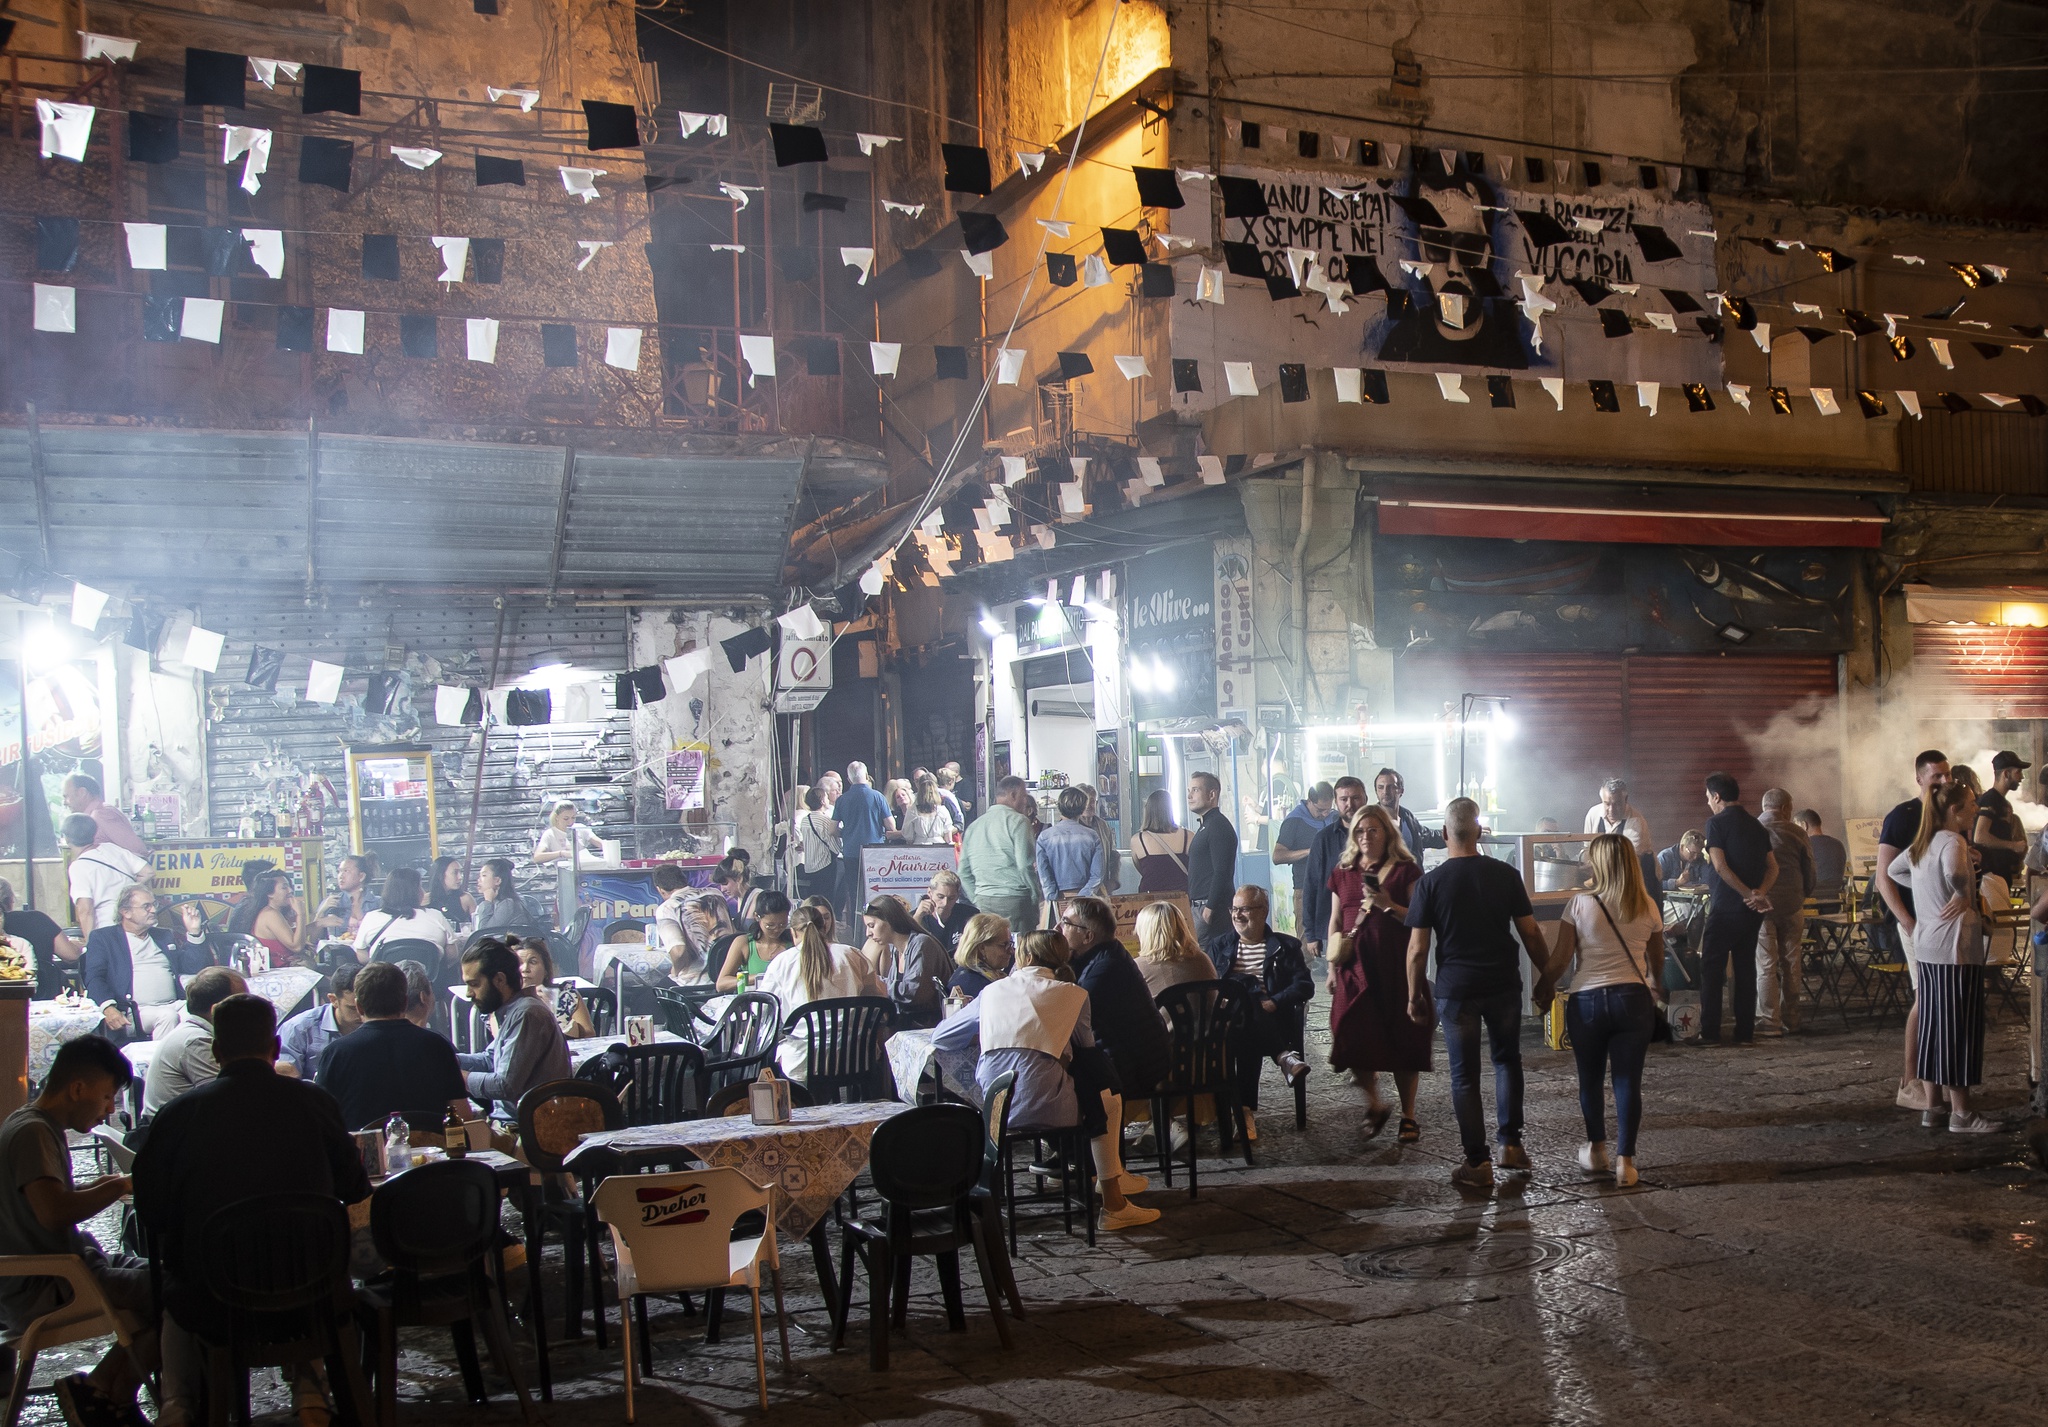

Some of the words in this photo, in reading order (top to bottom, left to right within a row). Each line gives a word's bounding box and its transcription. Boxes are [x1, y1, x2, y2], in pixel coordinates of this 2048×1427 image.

[1260, 183, 1310, 214] ANU
[1219, 583, 1233, 672] Monaco
[1221, 679, 1234, 708] Lo
[211, 875, 245, 887] BIRR
[878, 859, 951, 877] Maurizio
[641, 1193, 706, 1222] Dreher
